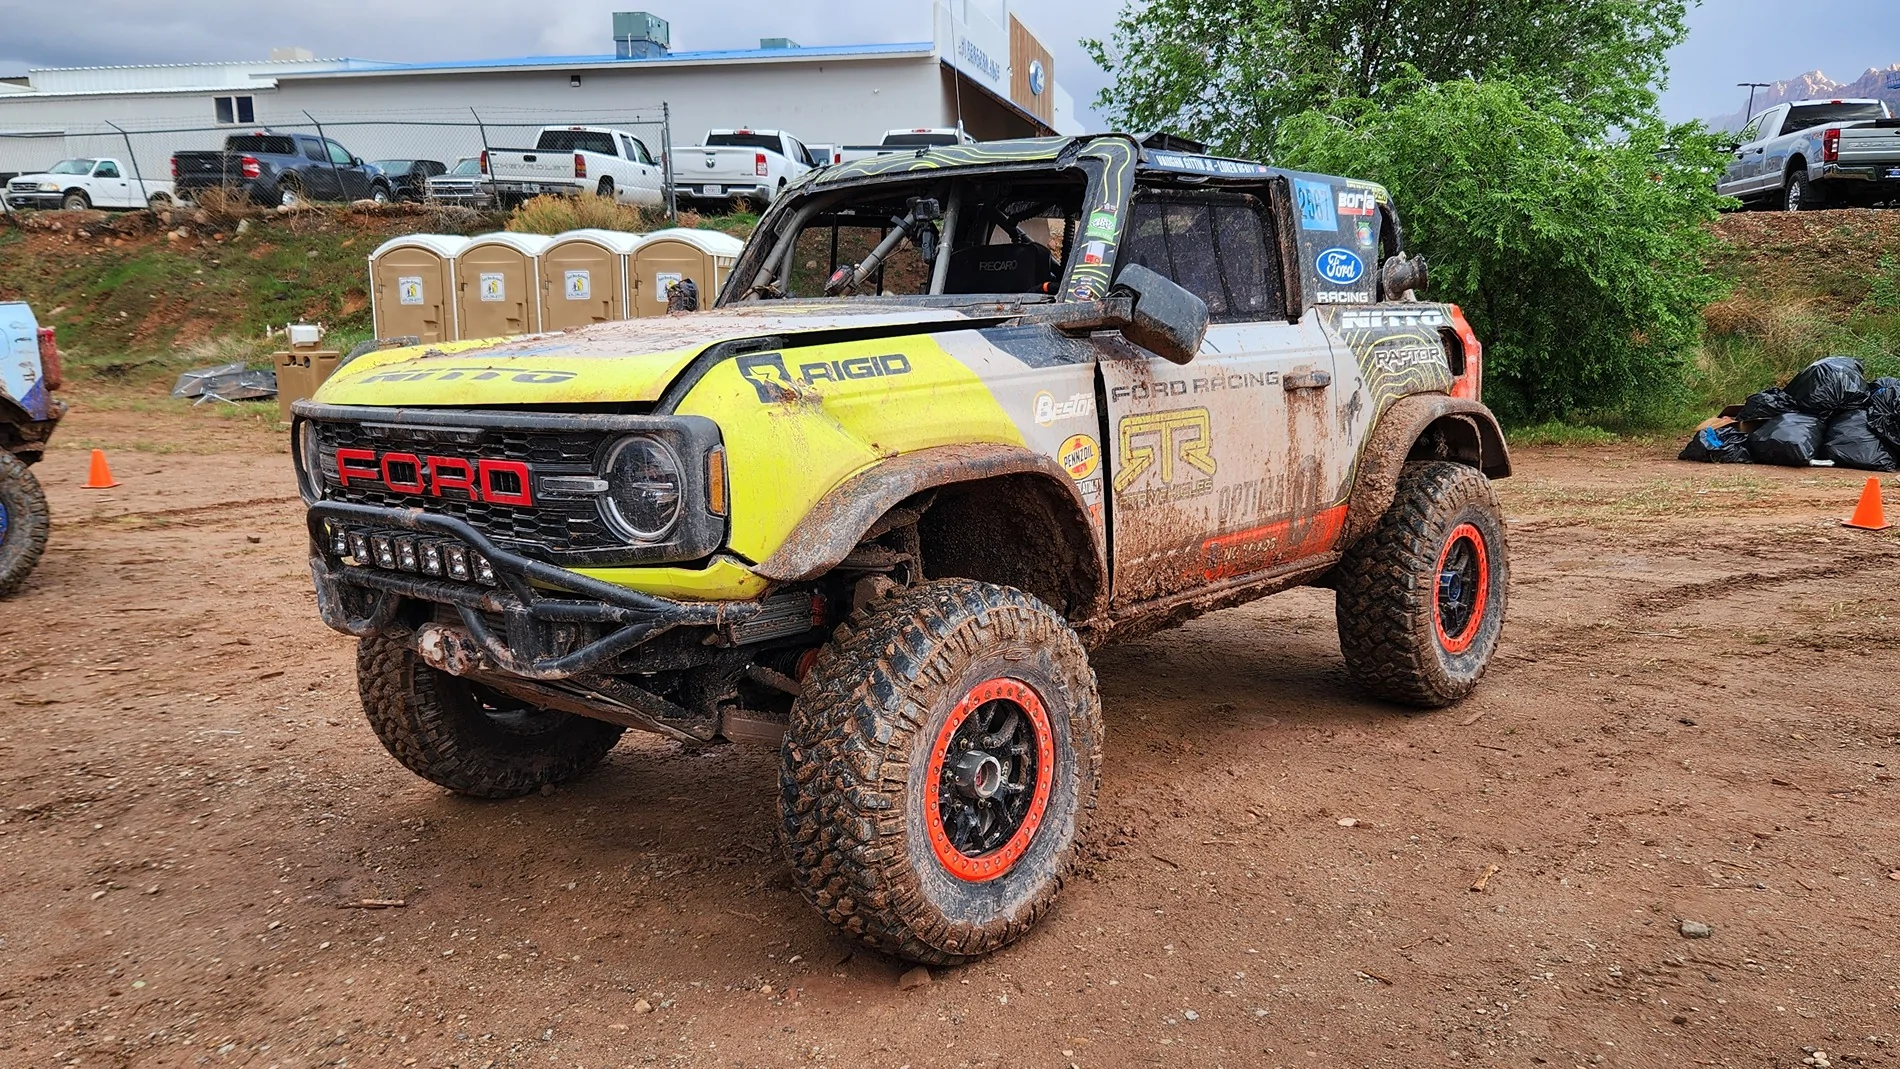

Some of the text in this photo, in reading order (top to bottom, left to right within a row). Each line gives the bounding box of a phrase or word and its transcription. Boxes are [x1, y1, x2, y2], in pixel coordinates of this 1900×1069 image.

[979, 260, 1018, 271] RECARO
[1316, 291, 1368, 303] RACING
[1341, 310, 1443, 329] NITTO
[799, 353, 912, 385] RIGID
[1374, 347, 1448, 373] RAPTOR
[357, 367, 578, 385] NITTO
[1111, 371, 1280, 403] FORD RACING
[1063, 444, 1095, 469] PENNZOIL
[336, 447, 534, 507] FORD
